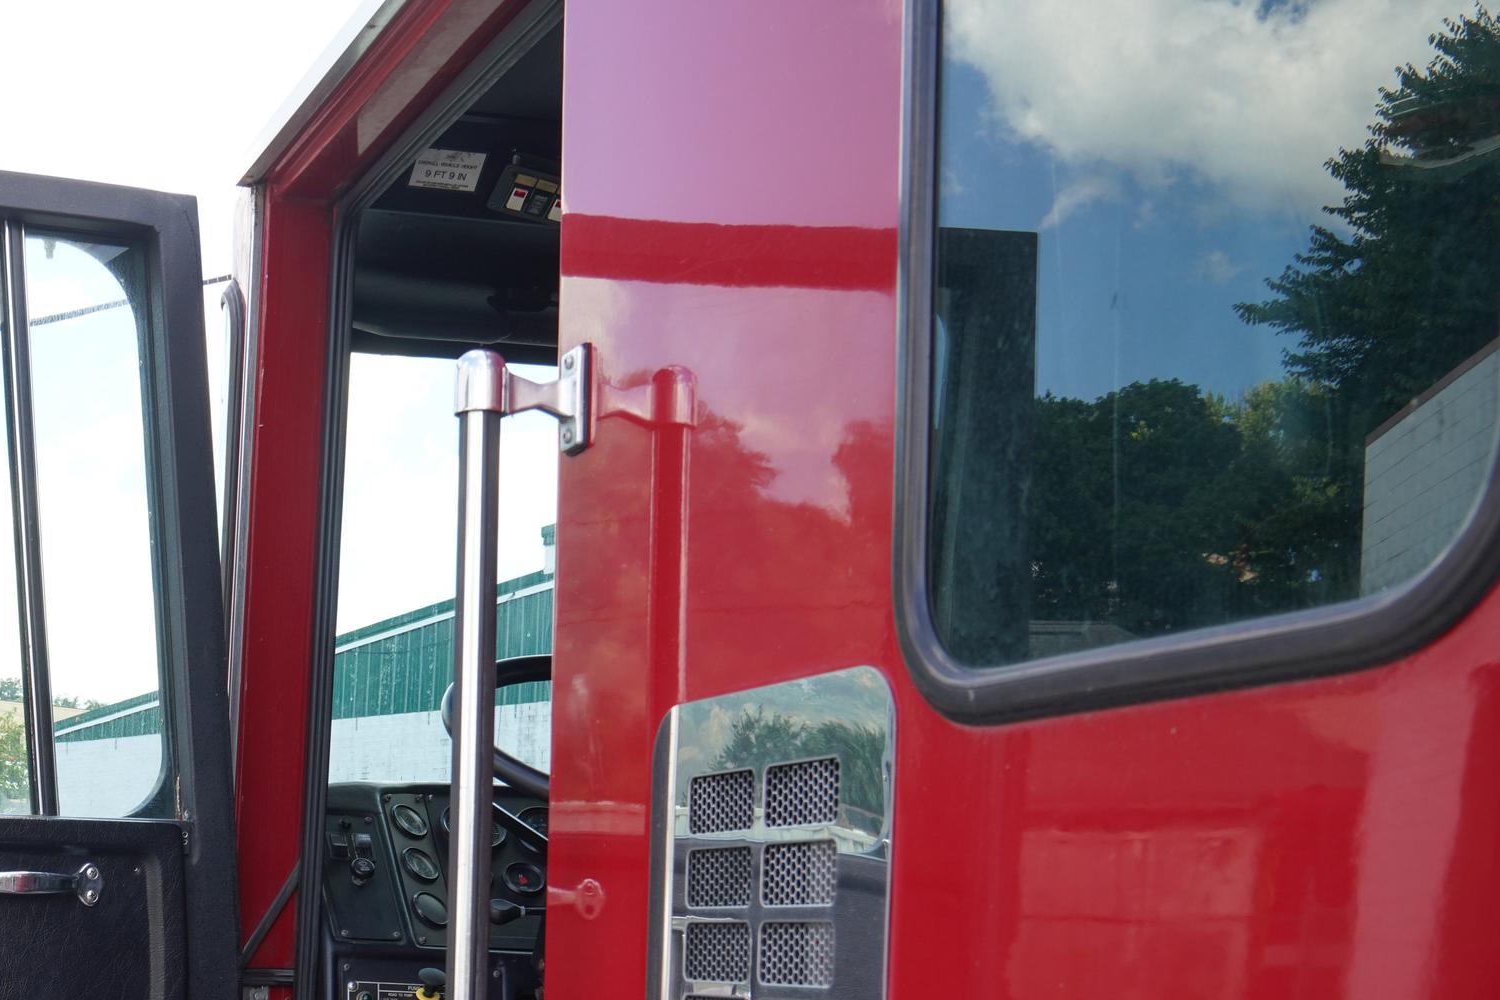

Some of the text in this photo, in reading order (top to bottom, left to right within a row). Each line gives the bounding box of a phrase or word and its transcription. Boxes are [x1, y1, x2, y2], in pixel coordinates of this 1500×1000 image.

[425, 169, 467, 181] 9 FT 9 IN
